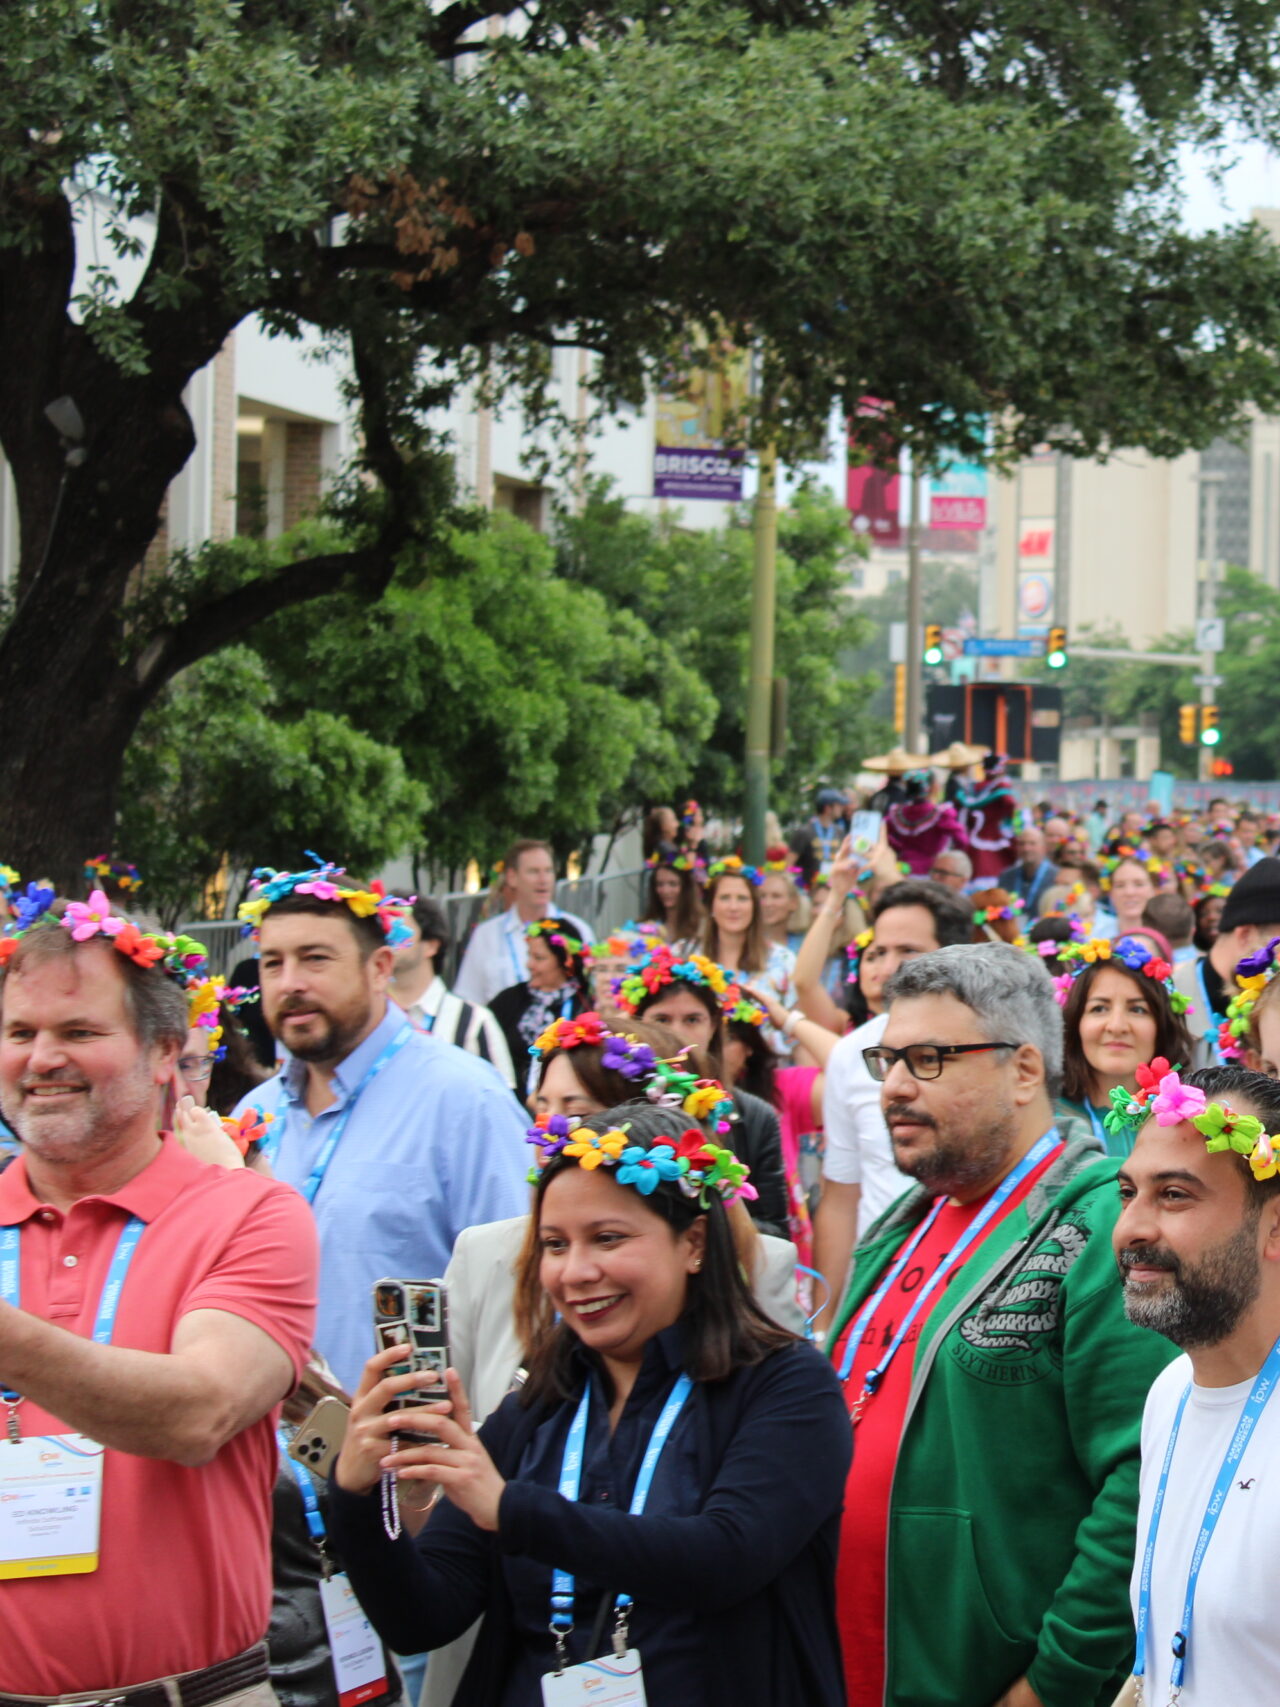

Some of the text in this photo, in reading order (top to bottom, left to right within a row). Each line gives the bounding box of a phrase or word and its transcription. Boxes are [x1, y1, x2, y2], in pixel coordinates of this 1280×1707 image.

[952, 1342, 1041, 1381] SLYTHERIN
[1251, 1378, 1271, 1404] ipw
[1226, 1415, 1249, 1465] AMERICAN
[1207, 1489, 1223, 1516] ipw
